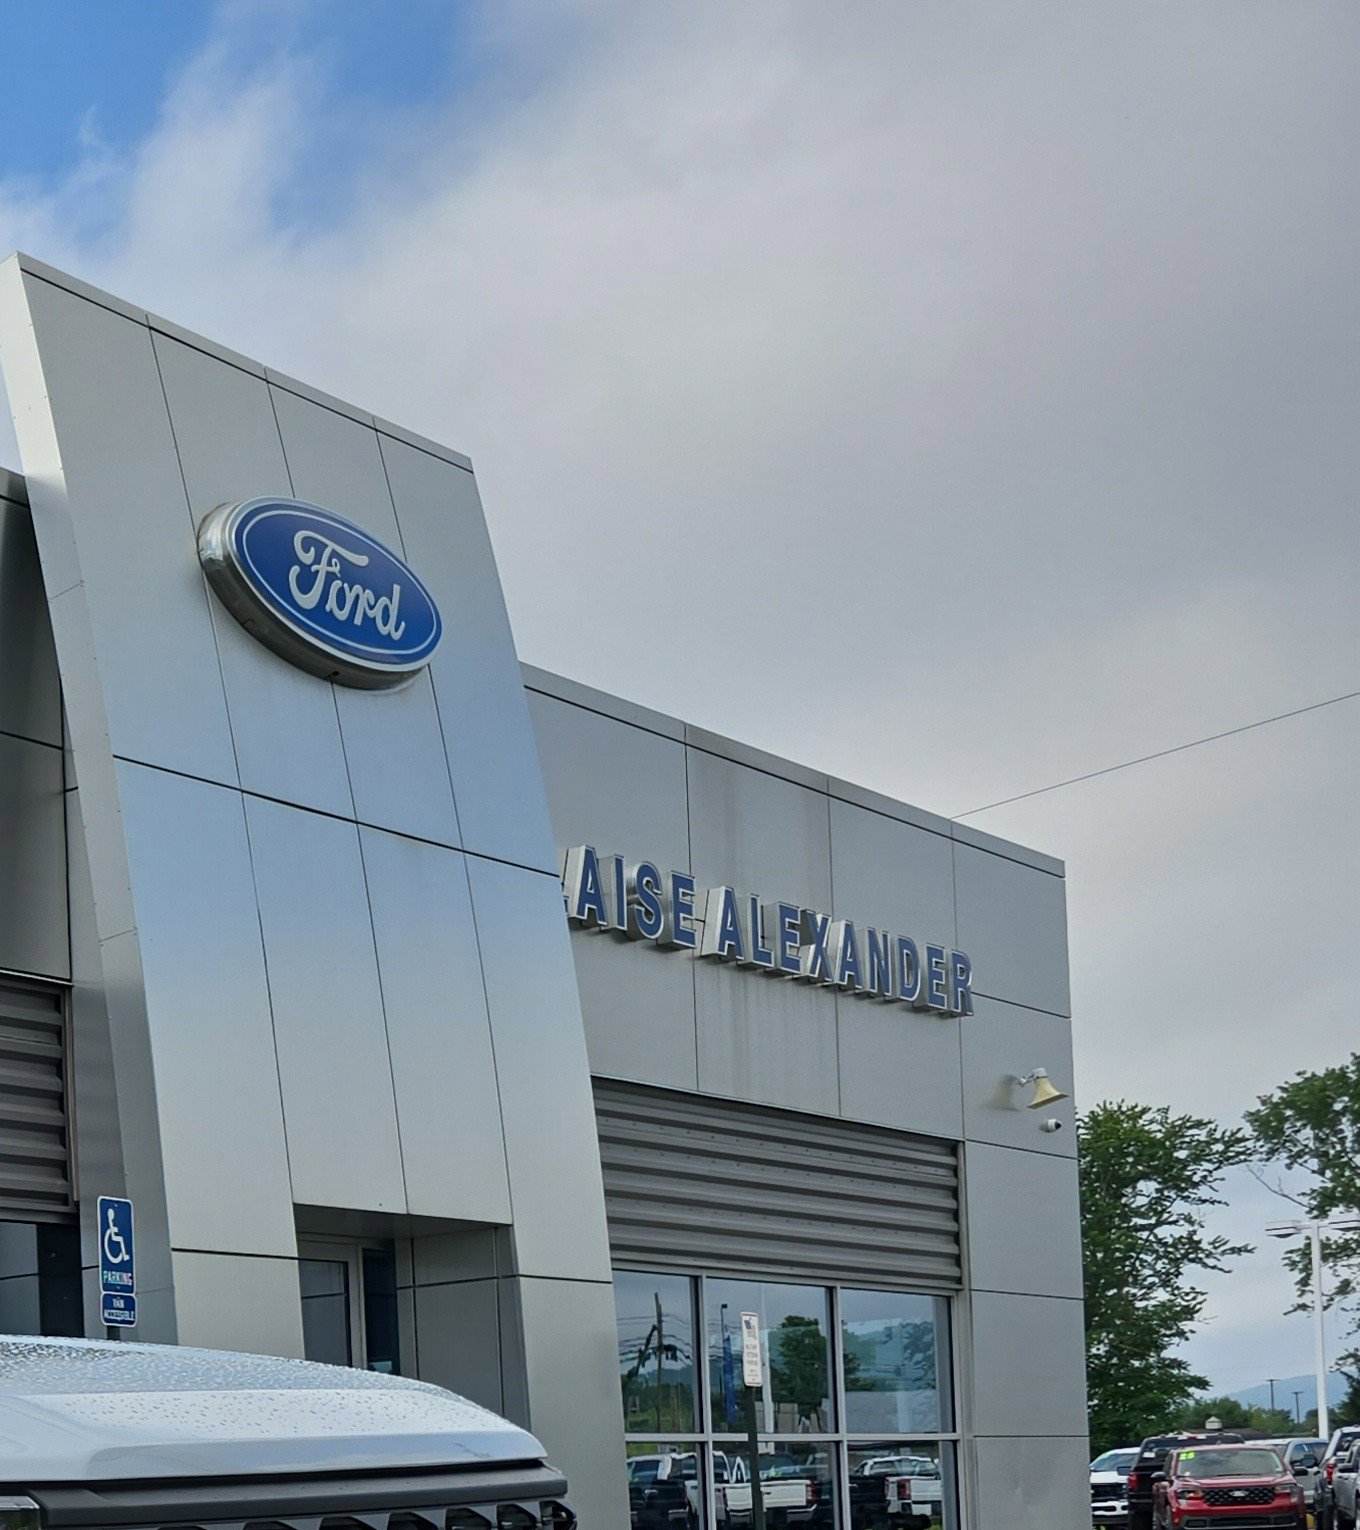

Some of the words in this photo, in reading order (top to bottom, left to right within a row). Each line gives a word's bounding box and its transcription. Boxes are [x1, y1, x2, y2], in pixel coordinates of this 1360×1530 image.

[288, 529, 405, 641] Ford
[564, 844, 696, 949] AISE
[708, 886, 975, 1017] ALEXANDER
[102, 1270, 133, 1286] PARKING
